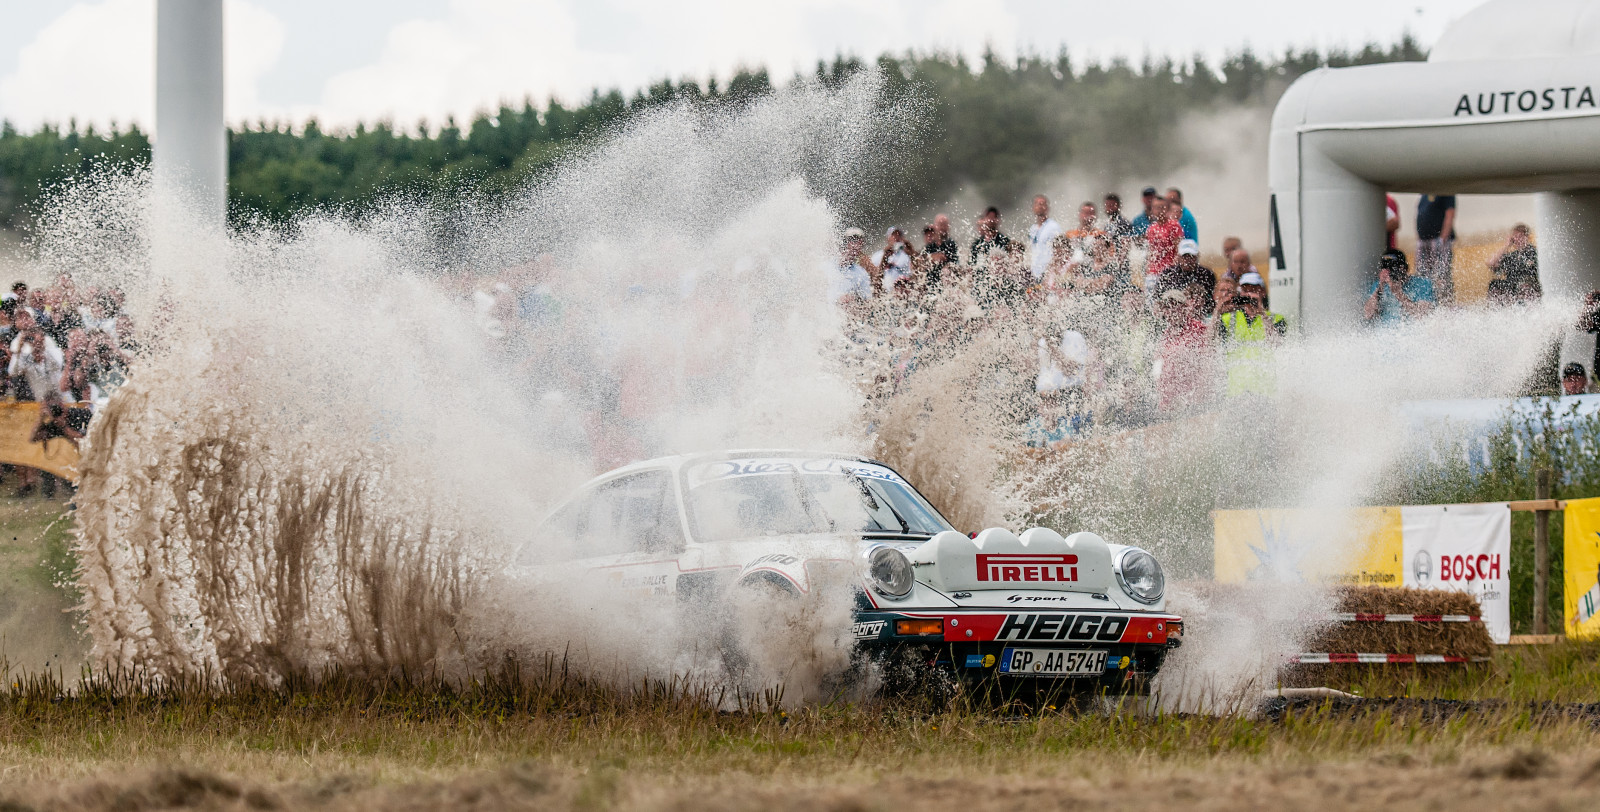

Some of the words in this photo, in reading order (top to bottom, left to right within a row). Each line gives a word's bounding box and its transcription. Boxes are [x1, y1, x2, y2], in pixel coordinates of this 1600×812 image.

[1453, 86, 1600, 116] AUTOSTA
[975, 553, 1079, 583] PIRELLI
[1440, 553, 1501, 582] BOSCH
[996, 614, 1129, 641] HEIGO
[1011, 651, 1034, 671] GP
[1043, 652, 1064, 672] AA
[1066, 652, 1107, 672] 574H
